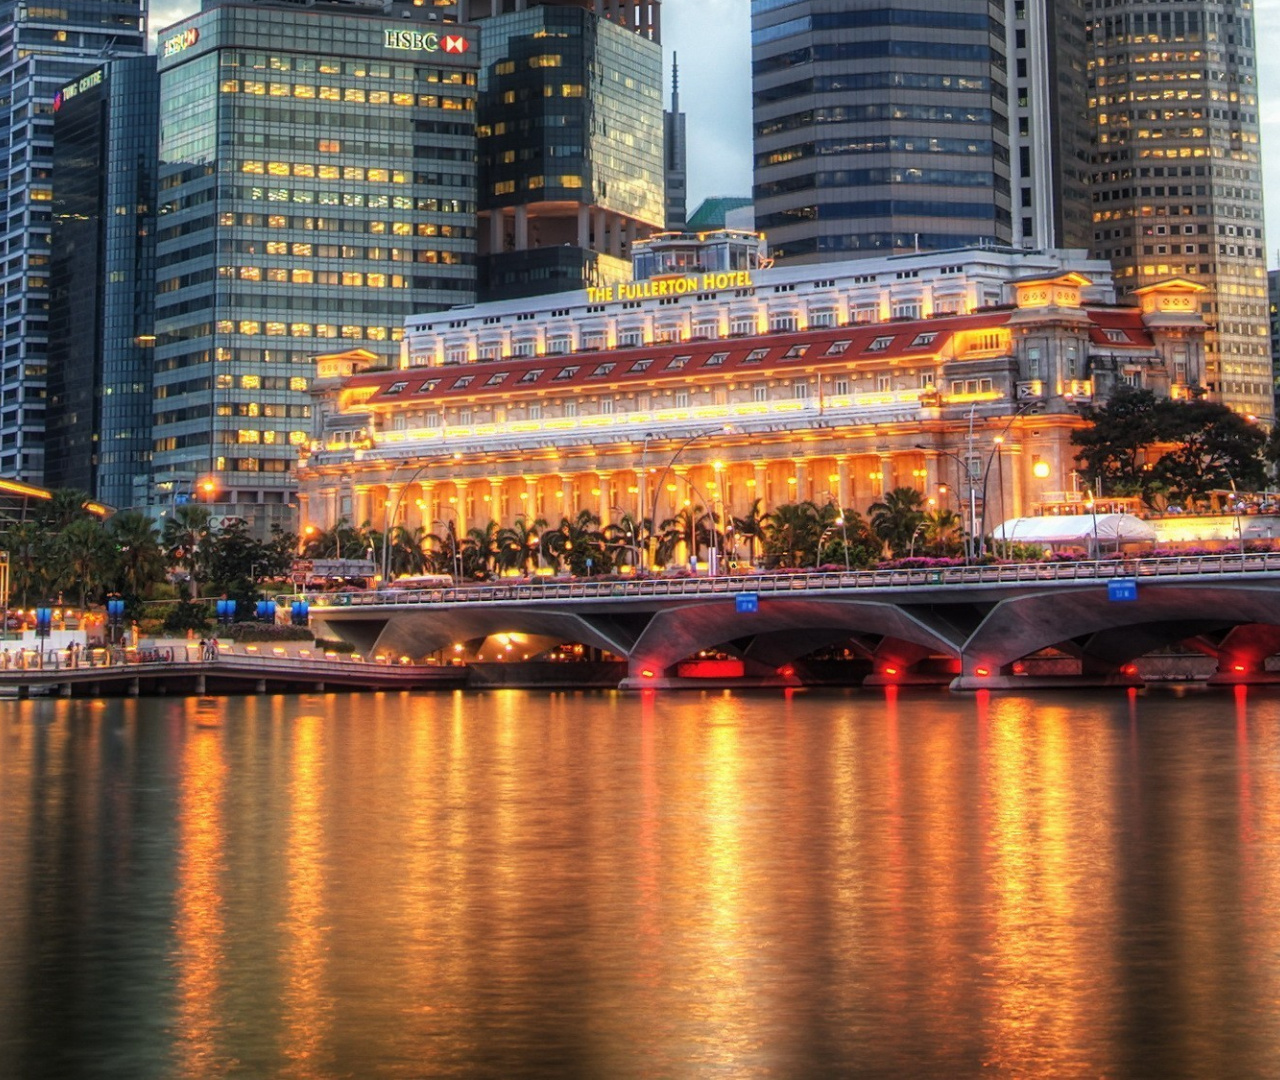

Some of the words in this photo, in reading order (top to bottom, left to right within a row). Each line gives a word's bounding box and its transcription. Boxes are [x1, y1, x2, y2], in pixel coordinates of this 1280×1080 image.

[384, 29, 438, 52] HSBC
[586, 286, 613, 303] THE
[617, 276, 698, 300] FULLERTON
[702, 270, 753, 290] HOTEL
